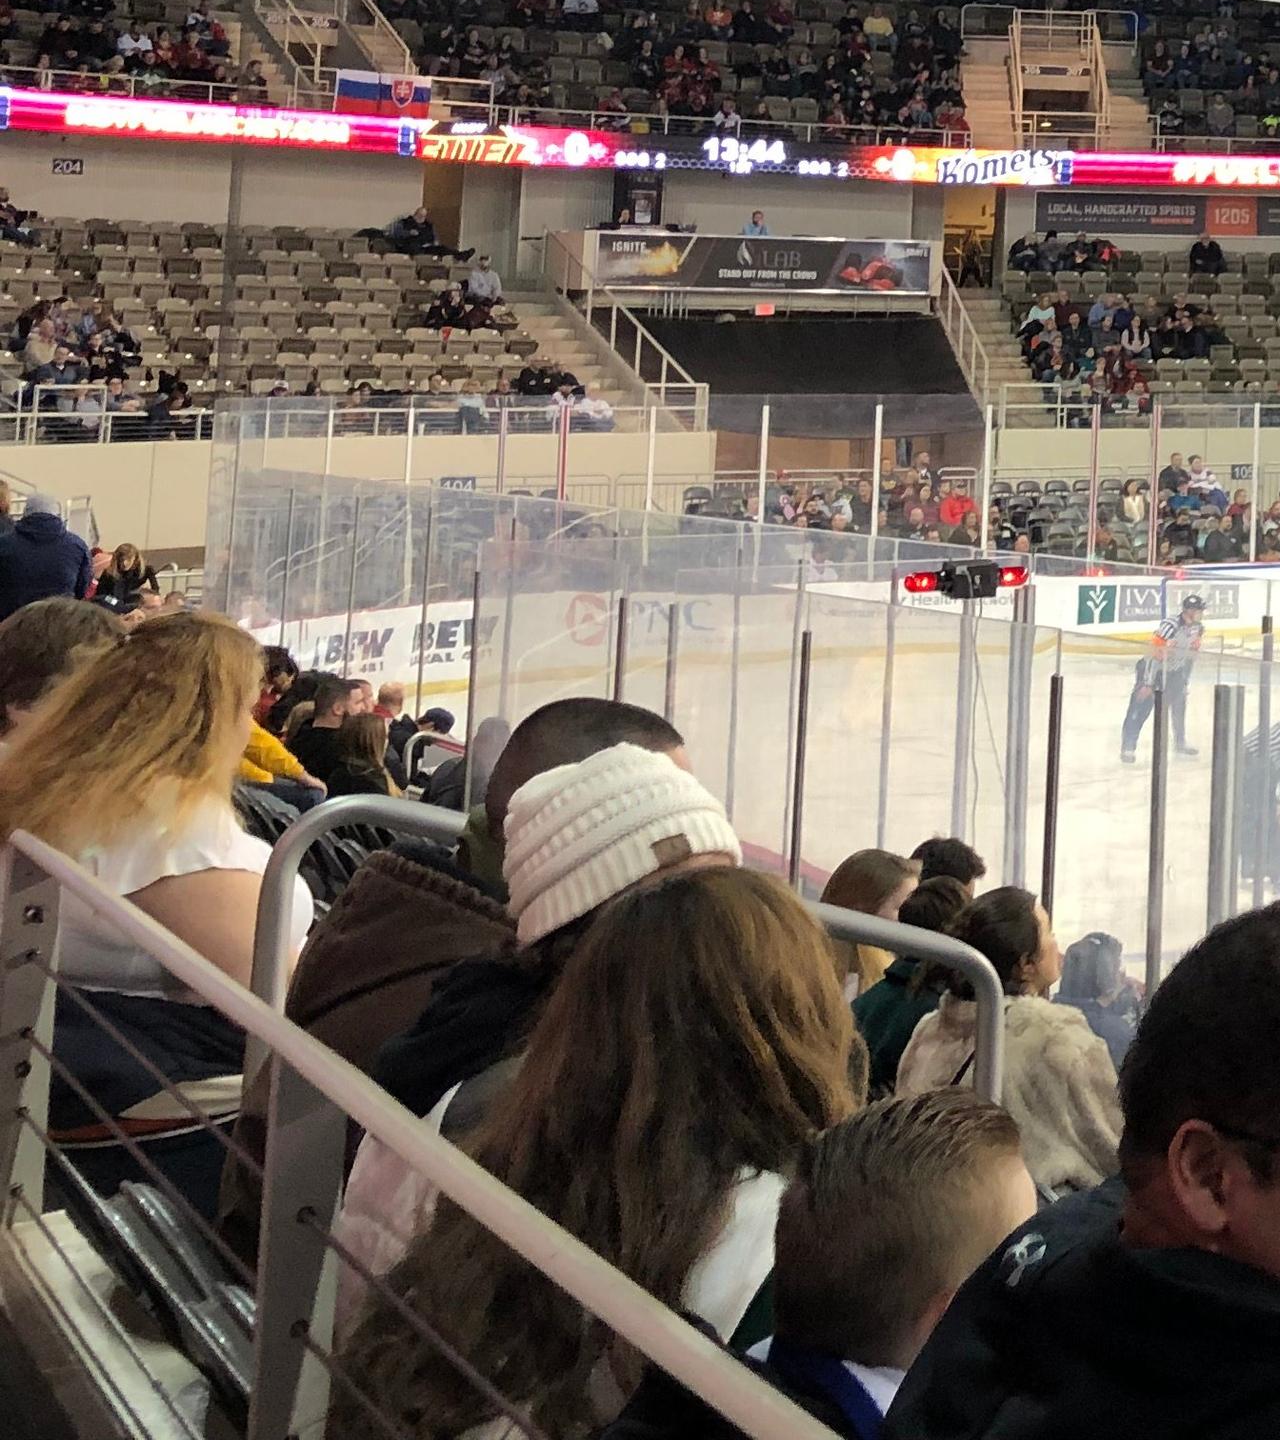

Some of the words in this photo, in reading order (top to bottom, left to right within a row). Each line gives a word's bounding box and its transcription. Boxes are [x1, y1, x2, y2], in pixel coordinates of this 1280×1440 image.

[703, 136, 786, 165] 13:44
[53, 160, 82, 175] 204
[936, 150, 1058, 184] Komets
[1047, 203, 1082, 216] LOCAL,
[1084, 204, 1157, 216] HANDCRAFTED
[1159, 204, 1197, 216] SPIRITS
[612, 240, 648, 253] IGNITE
[718, 268, 740, 279] STAND
[742, 269, 756, 279] OUT
[757, 269, 777, 280] FROM
[778, 269, 791, 279] THE
[792, 270, 818, 281] CROWD
[1125, 588, 1162, 606] IVY
[630, 598, 717, 632] PNC
